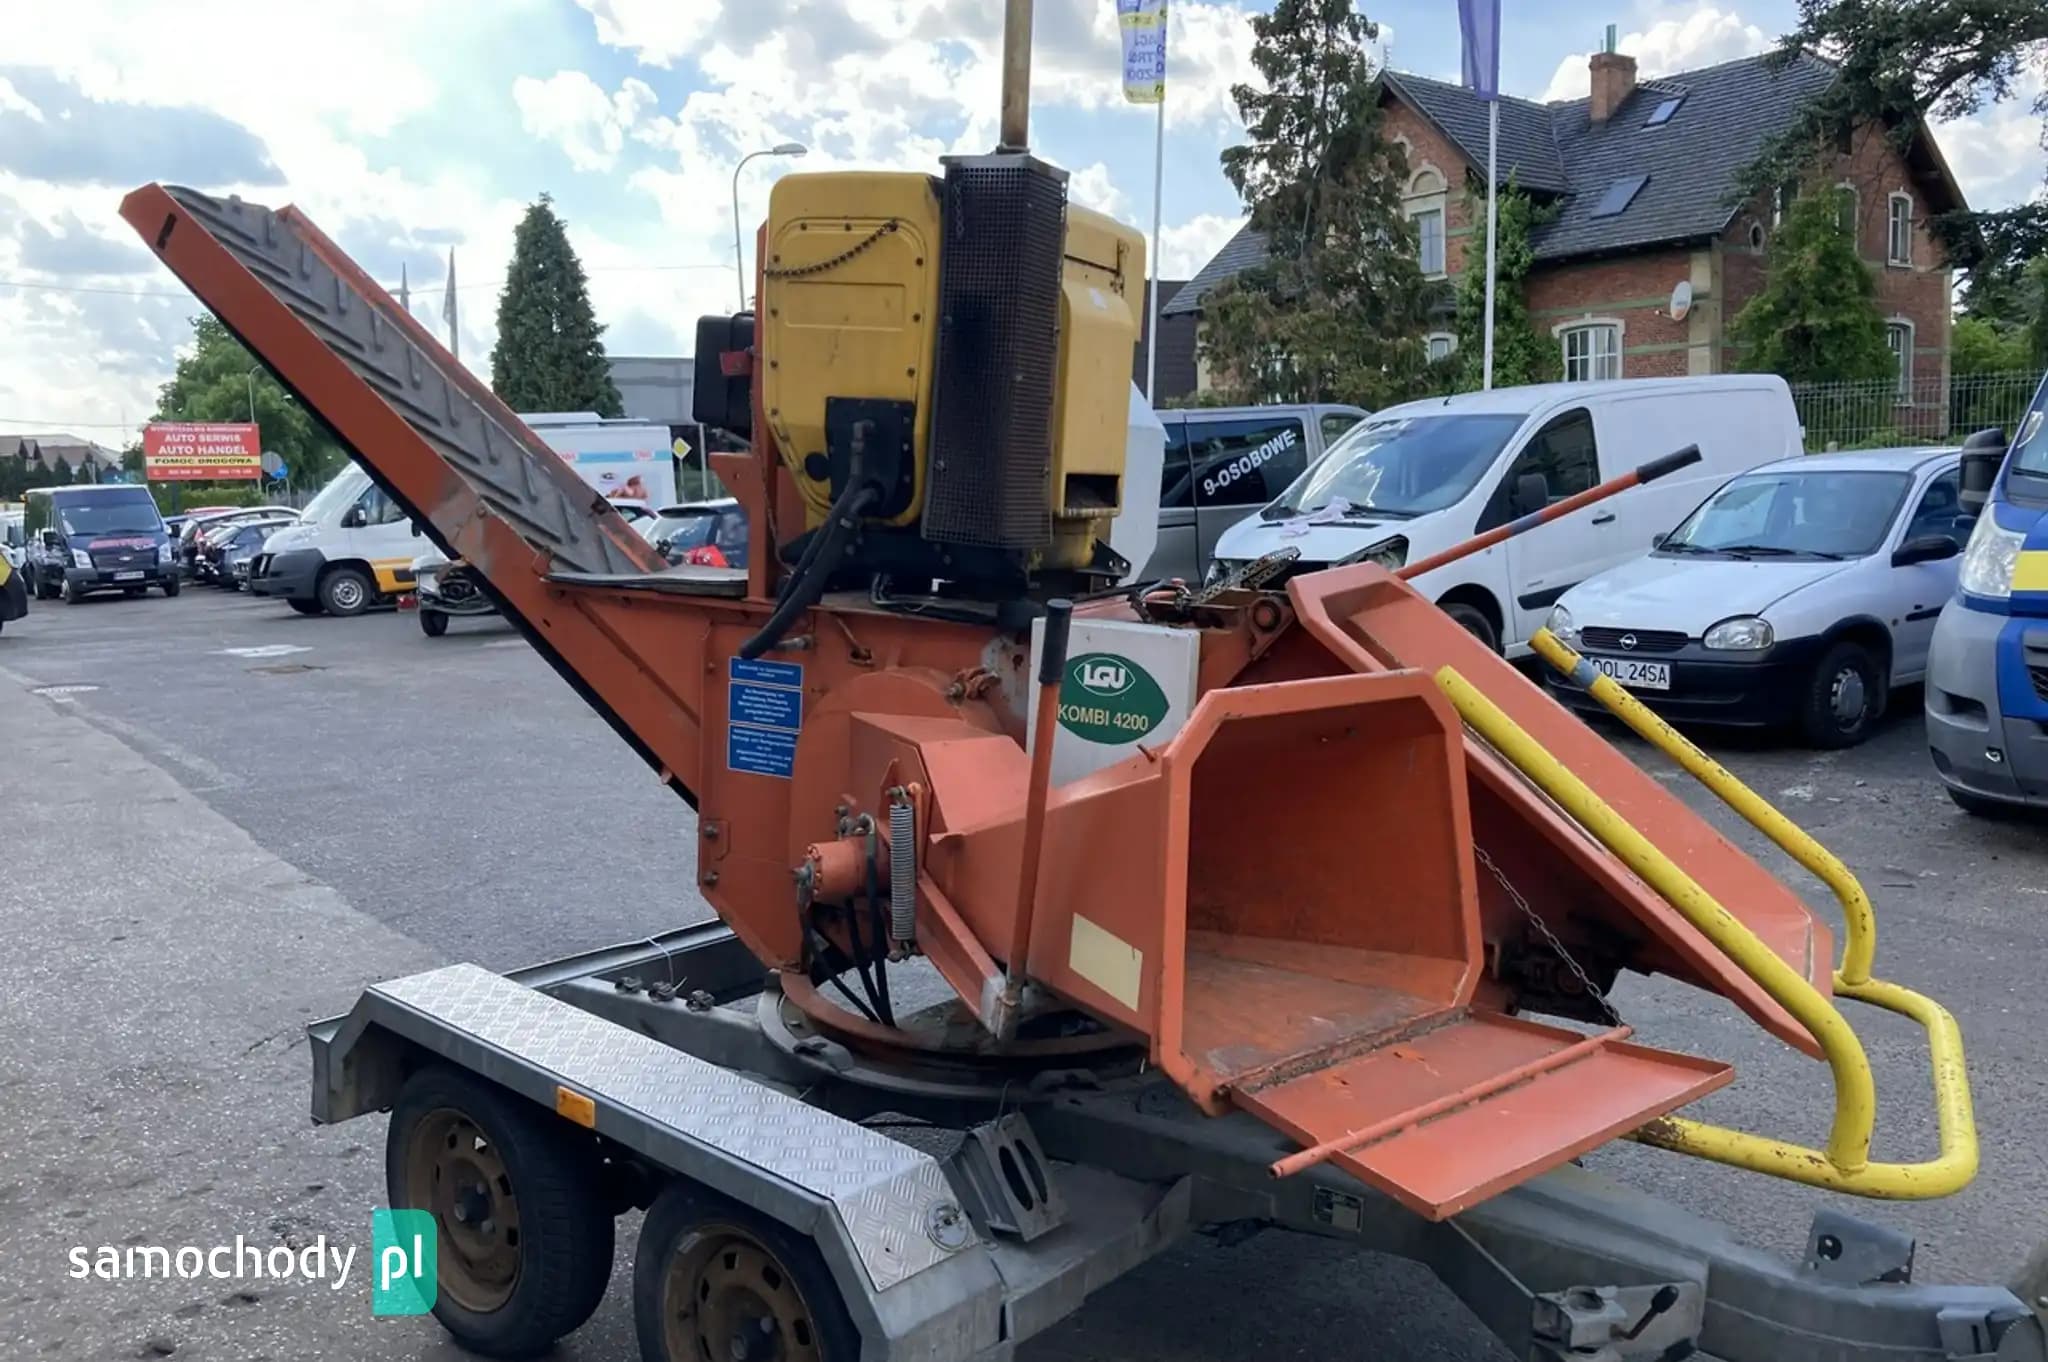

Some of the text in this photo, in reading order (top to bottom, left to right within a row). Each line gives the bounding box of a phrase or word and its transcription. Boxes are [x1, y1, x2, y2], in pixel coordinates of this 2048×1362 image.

[164, 433, 242, 443] AUTO SERWIS
[158, 445, 249, 455] AUTO HANDEL
[1629, 663, 1667, 684] 24SA
[1057, 703, 1149, 732] KOMBI 4200
